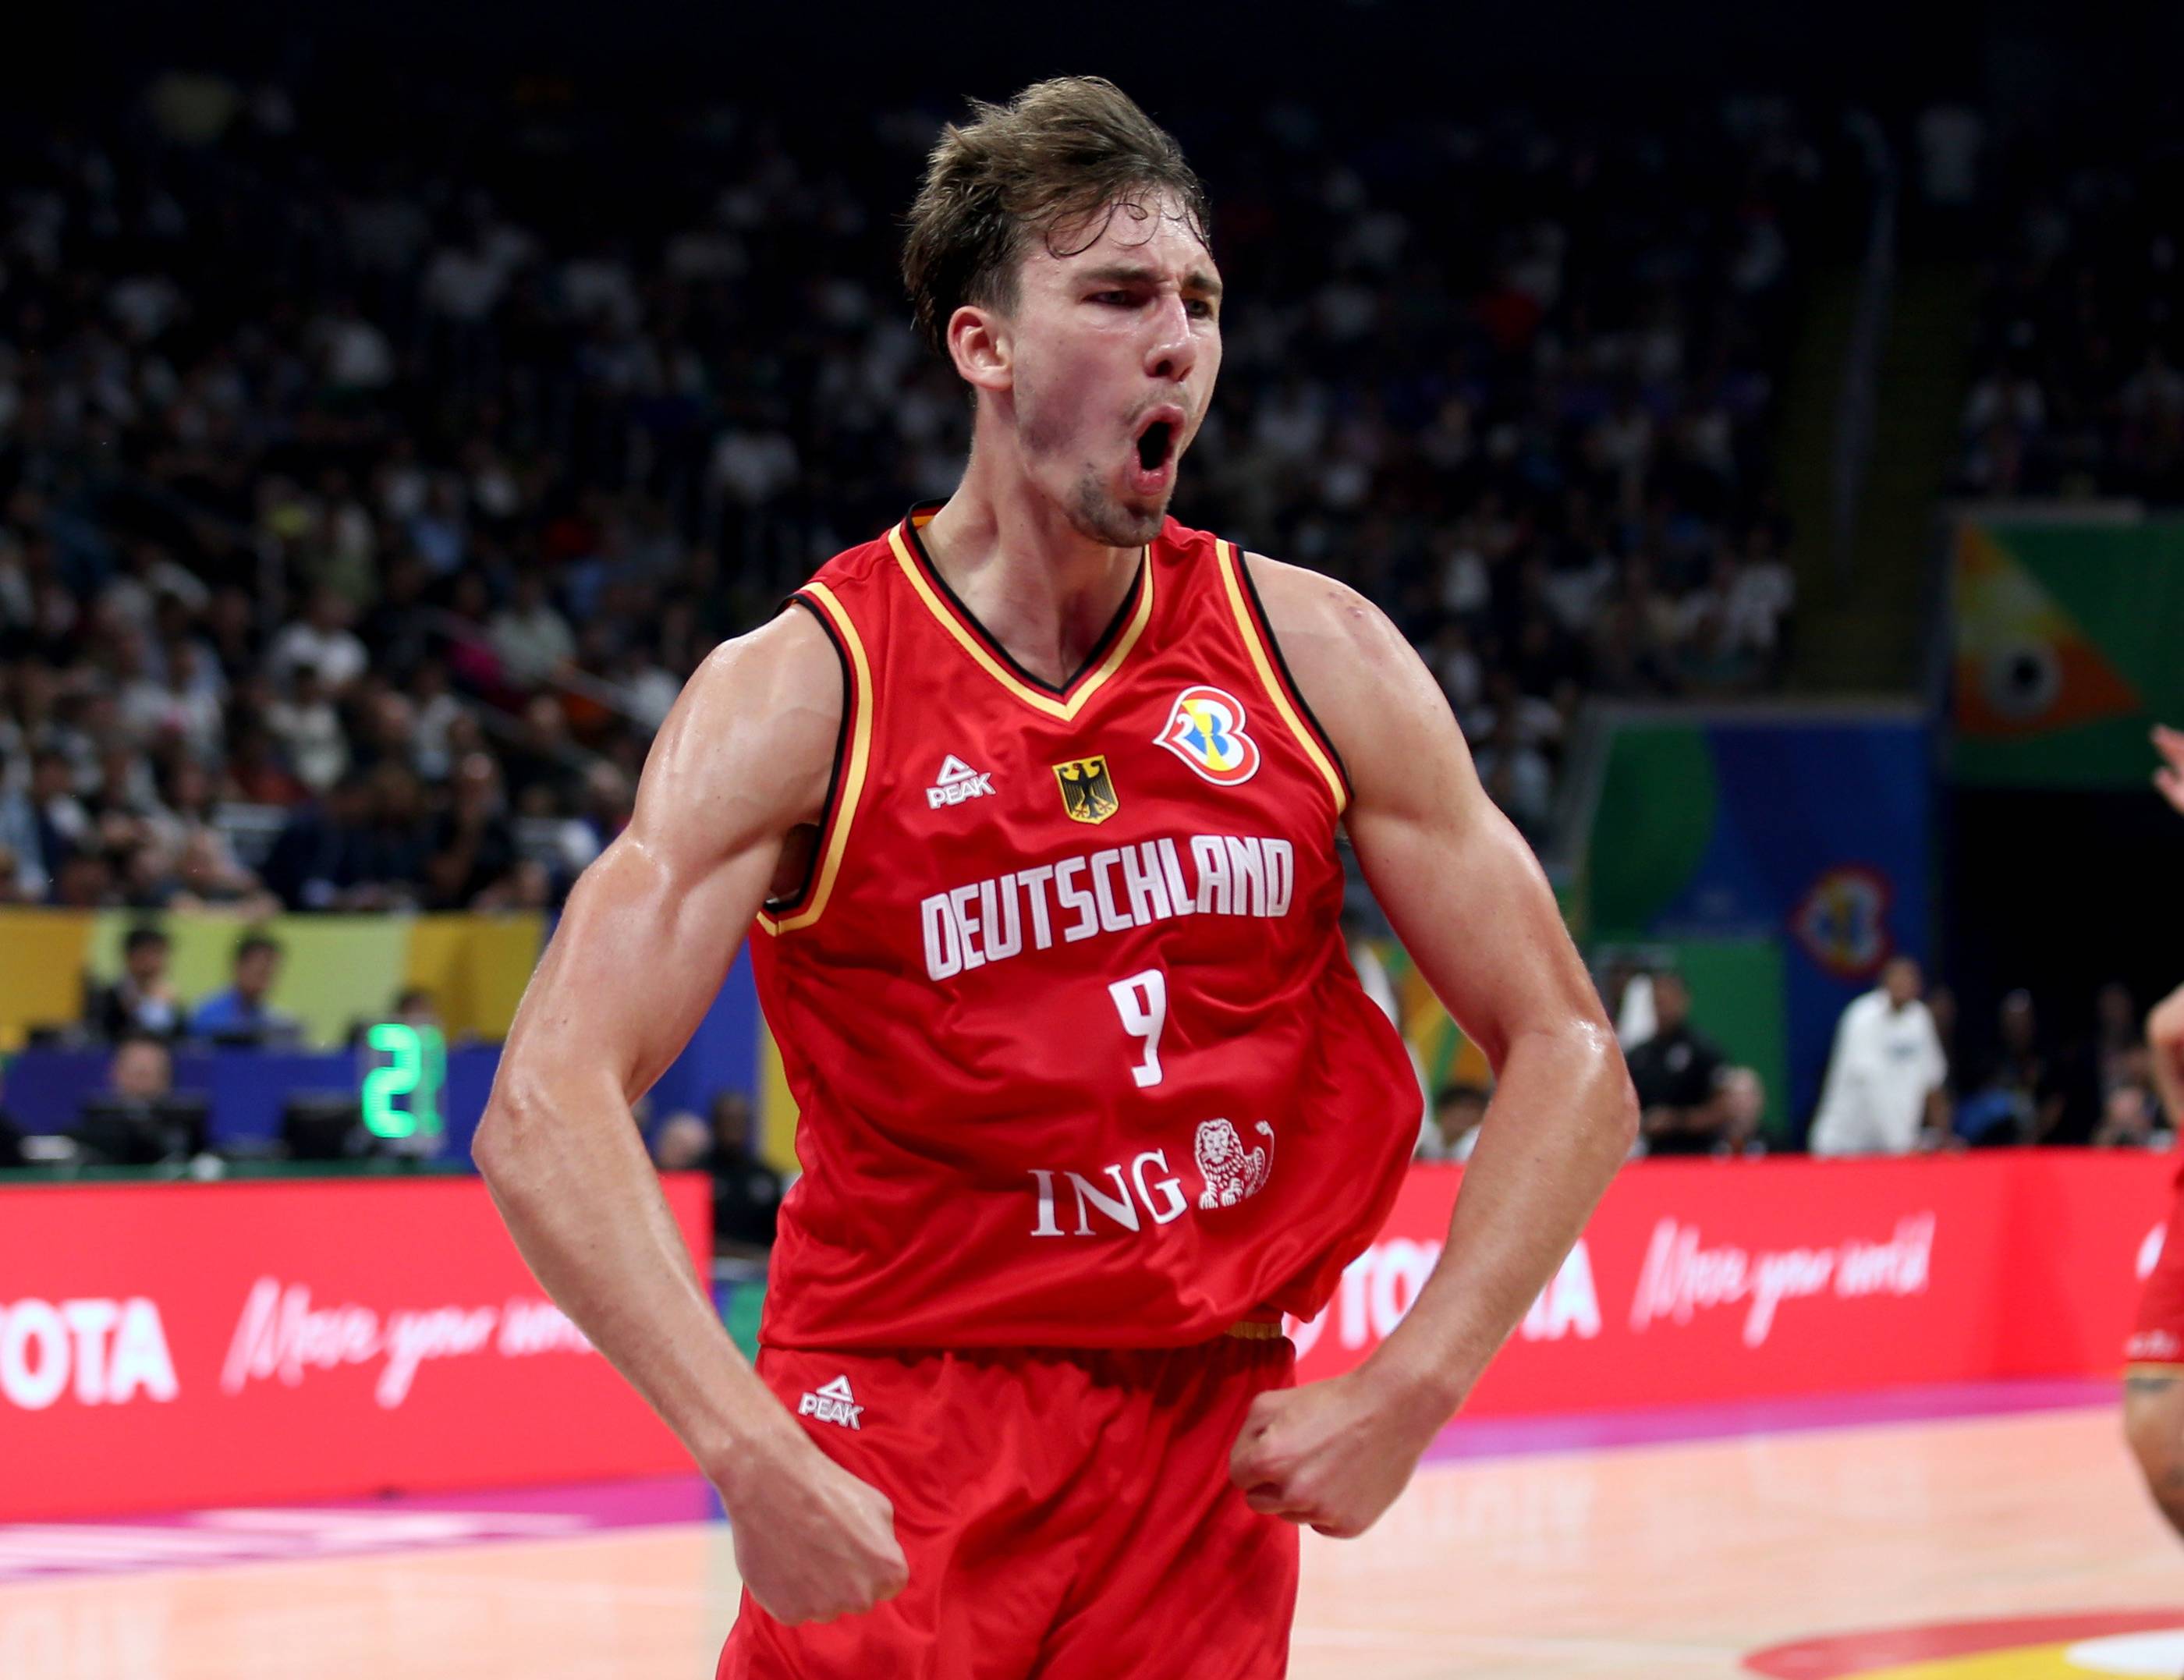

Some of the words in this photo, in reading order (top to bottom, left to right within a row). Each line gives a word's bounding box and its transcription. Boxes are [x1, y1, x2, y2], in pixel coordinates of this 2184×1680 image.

[926, 772, 997, 810] PEAK
[920, 835, 1294, 981] DEUTSCHLAND
[1108, 968, 1168, 1088] 9
[1027, 1147, 1188, 1236] ING
[0, 1296, 180, 1410] OTA
[798, 1392, 864, 1430] PEAK
